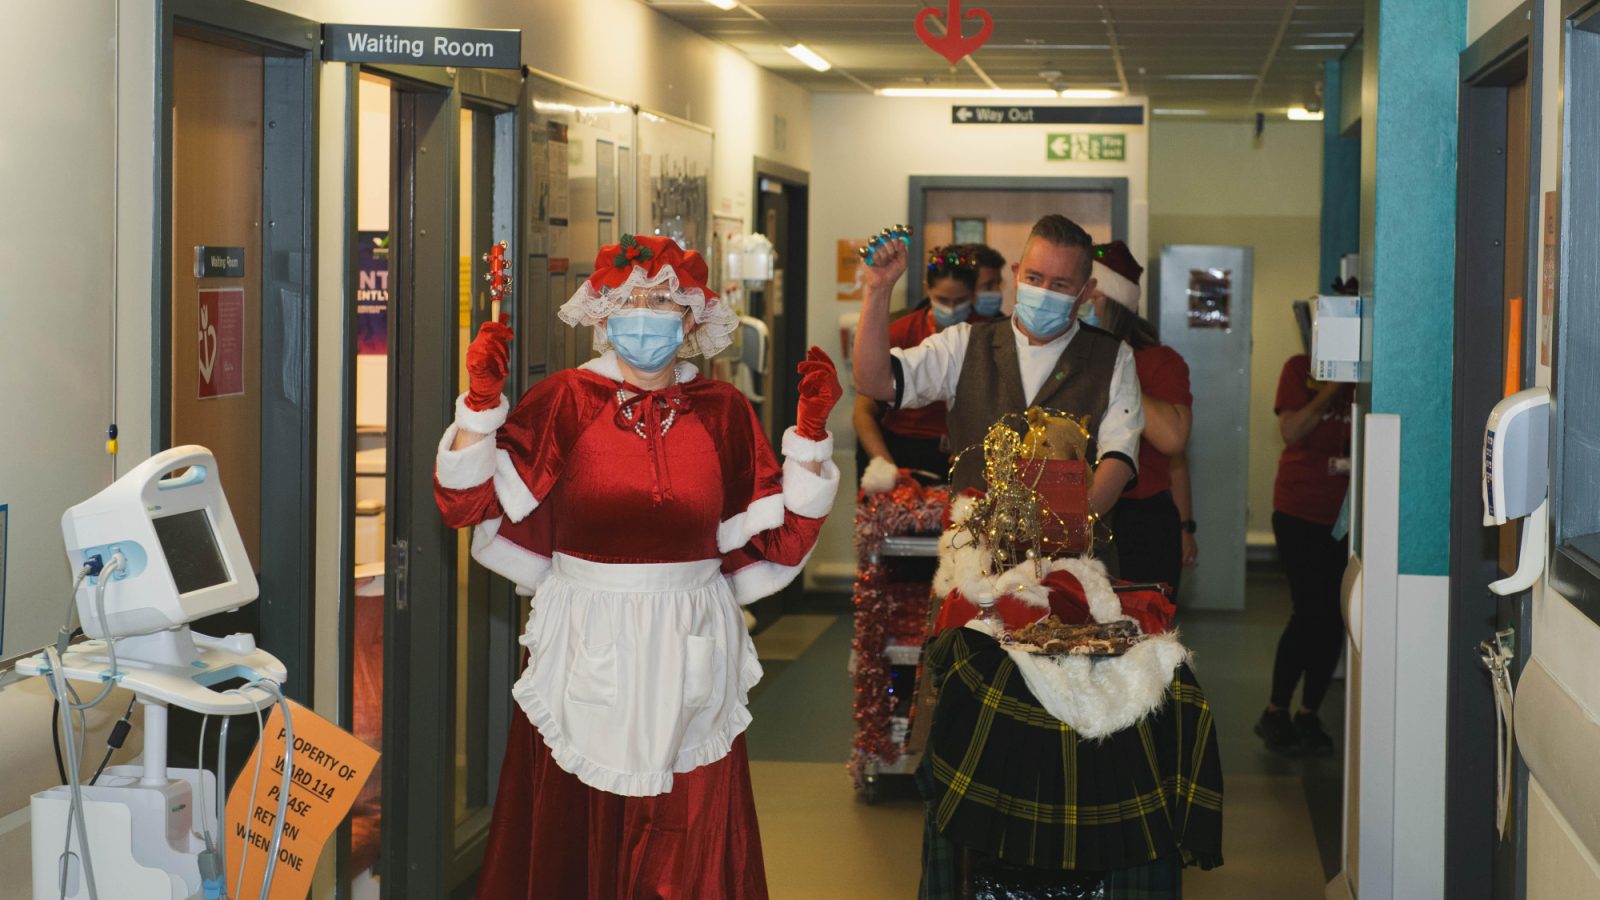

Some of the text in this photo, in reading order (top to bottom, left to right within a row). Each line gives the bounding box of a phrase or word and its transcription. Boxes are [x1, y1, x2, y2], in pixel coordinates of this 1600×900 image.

[347, 32, 494, 58] Waiting Room
[975, 108, 1034, 122] Way Out
[276, 727, 357, 781] POPERTY OF
[267, 785, 312, 817] PLASE
[311, 779, 336, 800] 114
[253, 805, 300, 841] RETRN
[236, 822, 303, 872] WHEN ONE
